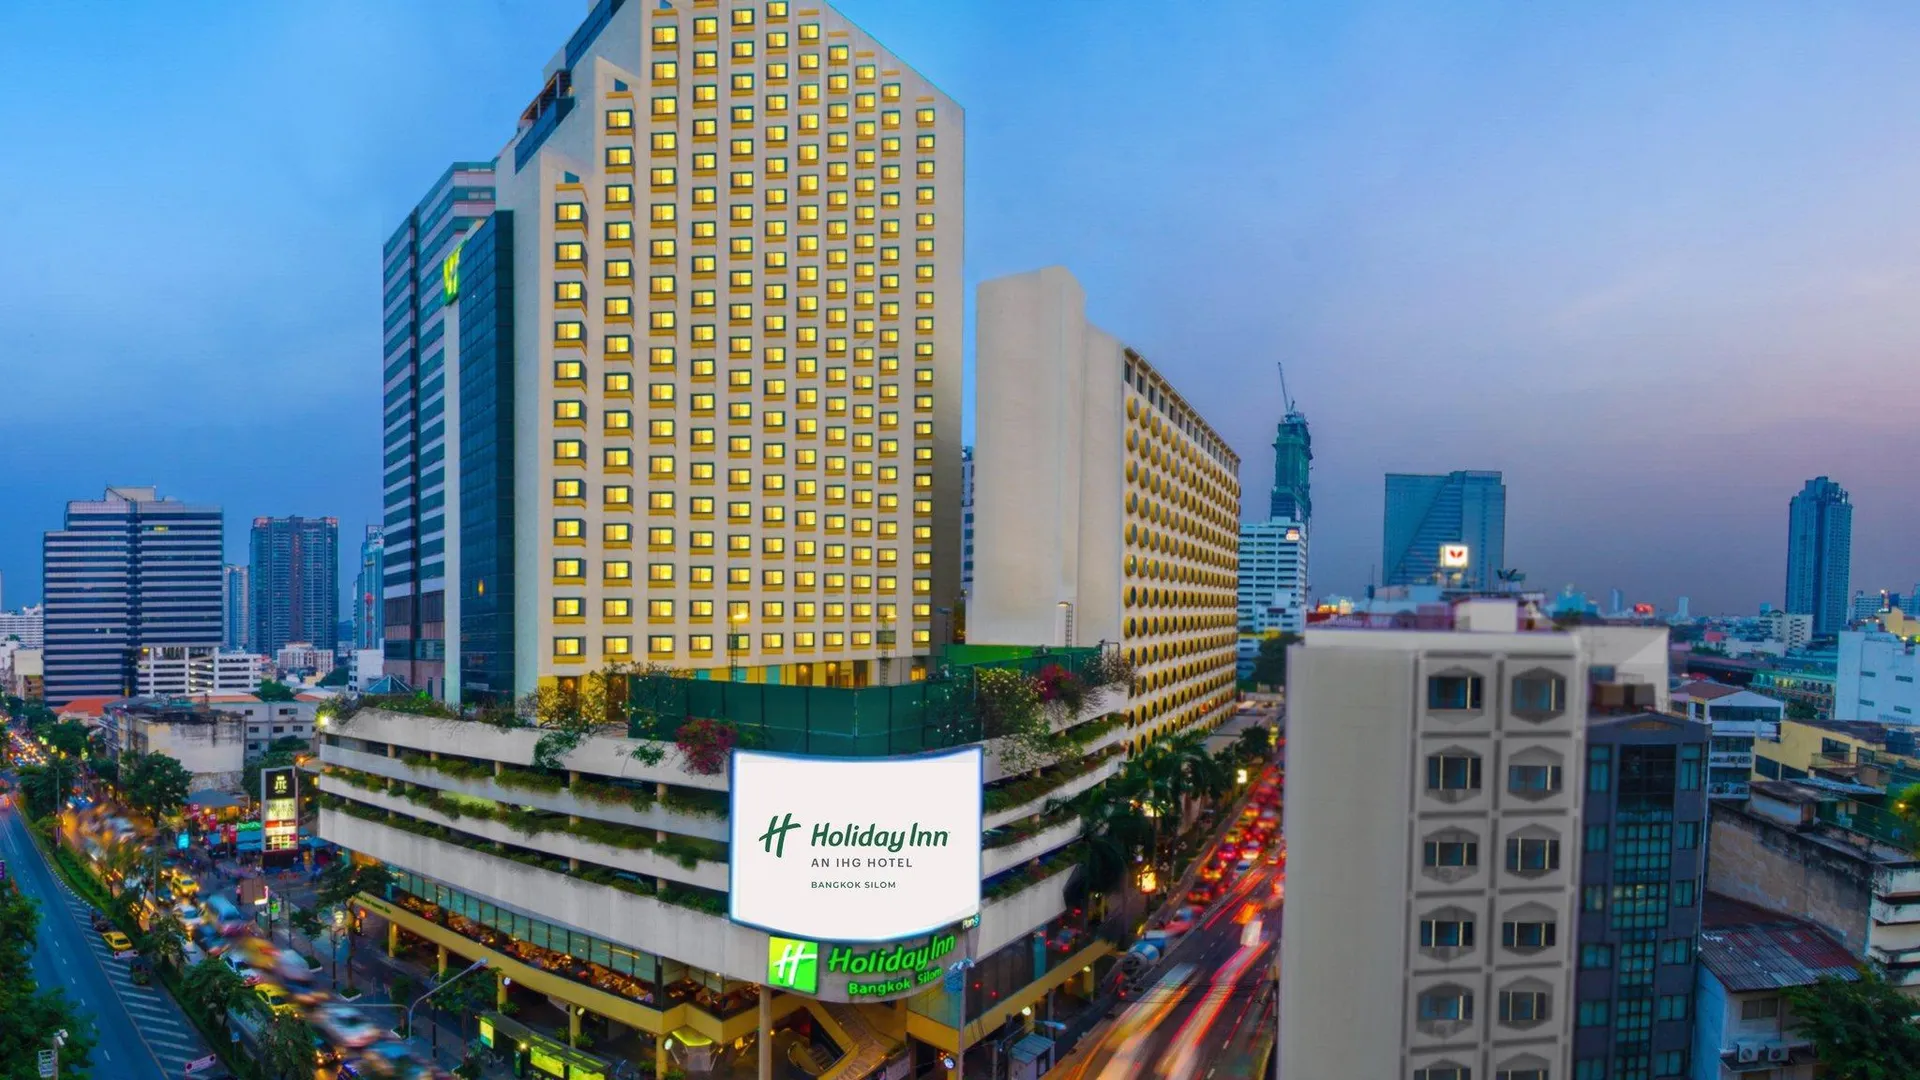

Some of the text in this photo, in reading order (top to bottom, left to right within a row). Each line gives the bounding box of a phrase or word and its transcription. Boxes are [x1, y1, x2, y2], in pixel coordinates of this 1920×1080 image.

[811, 823, 948, 852] Holiday Inn
[810, 857, 913, 868] AN IHG HOTEL
[811, 881, 896, 889] BANGKOK SILOM
[828, 934, 956, 974] Holiday Inn
[849, 966, 943, 996] Bangkok Silom
